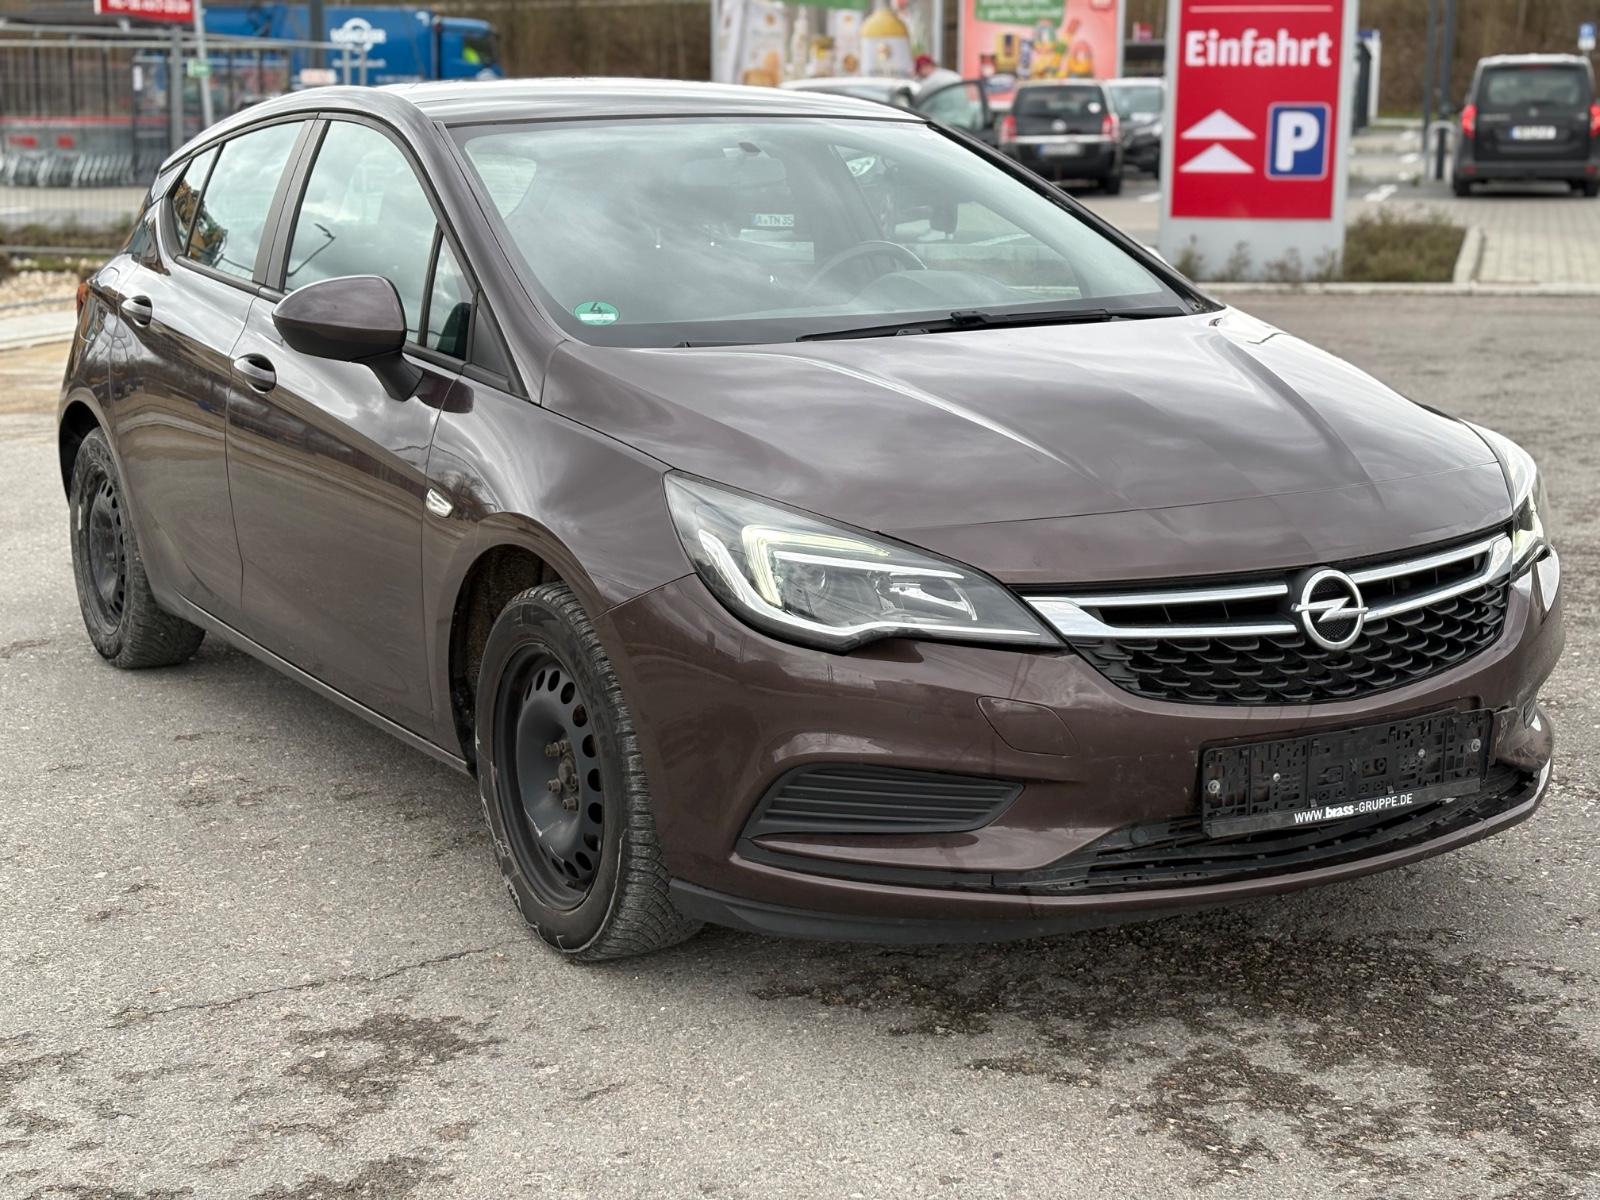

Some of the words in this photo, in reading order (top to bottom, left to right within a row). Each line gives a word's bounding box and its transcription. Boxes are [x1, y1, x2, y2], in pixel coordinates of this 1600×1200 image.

[1185, 28, 1334, 67] Einfahrt
[1275, 110, 1321, 172] P
[590, 302, 603, 314] 4
[1293, 793, 1413, 824] WWW.brass-GRUPPE.DE
